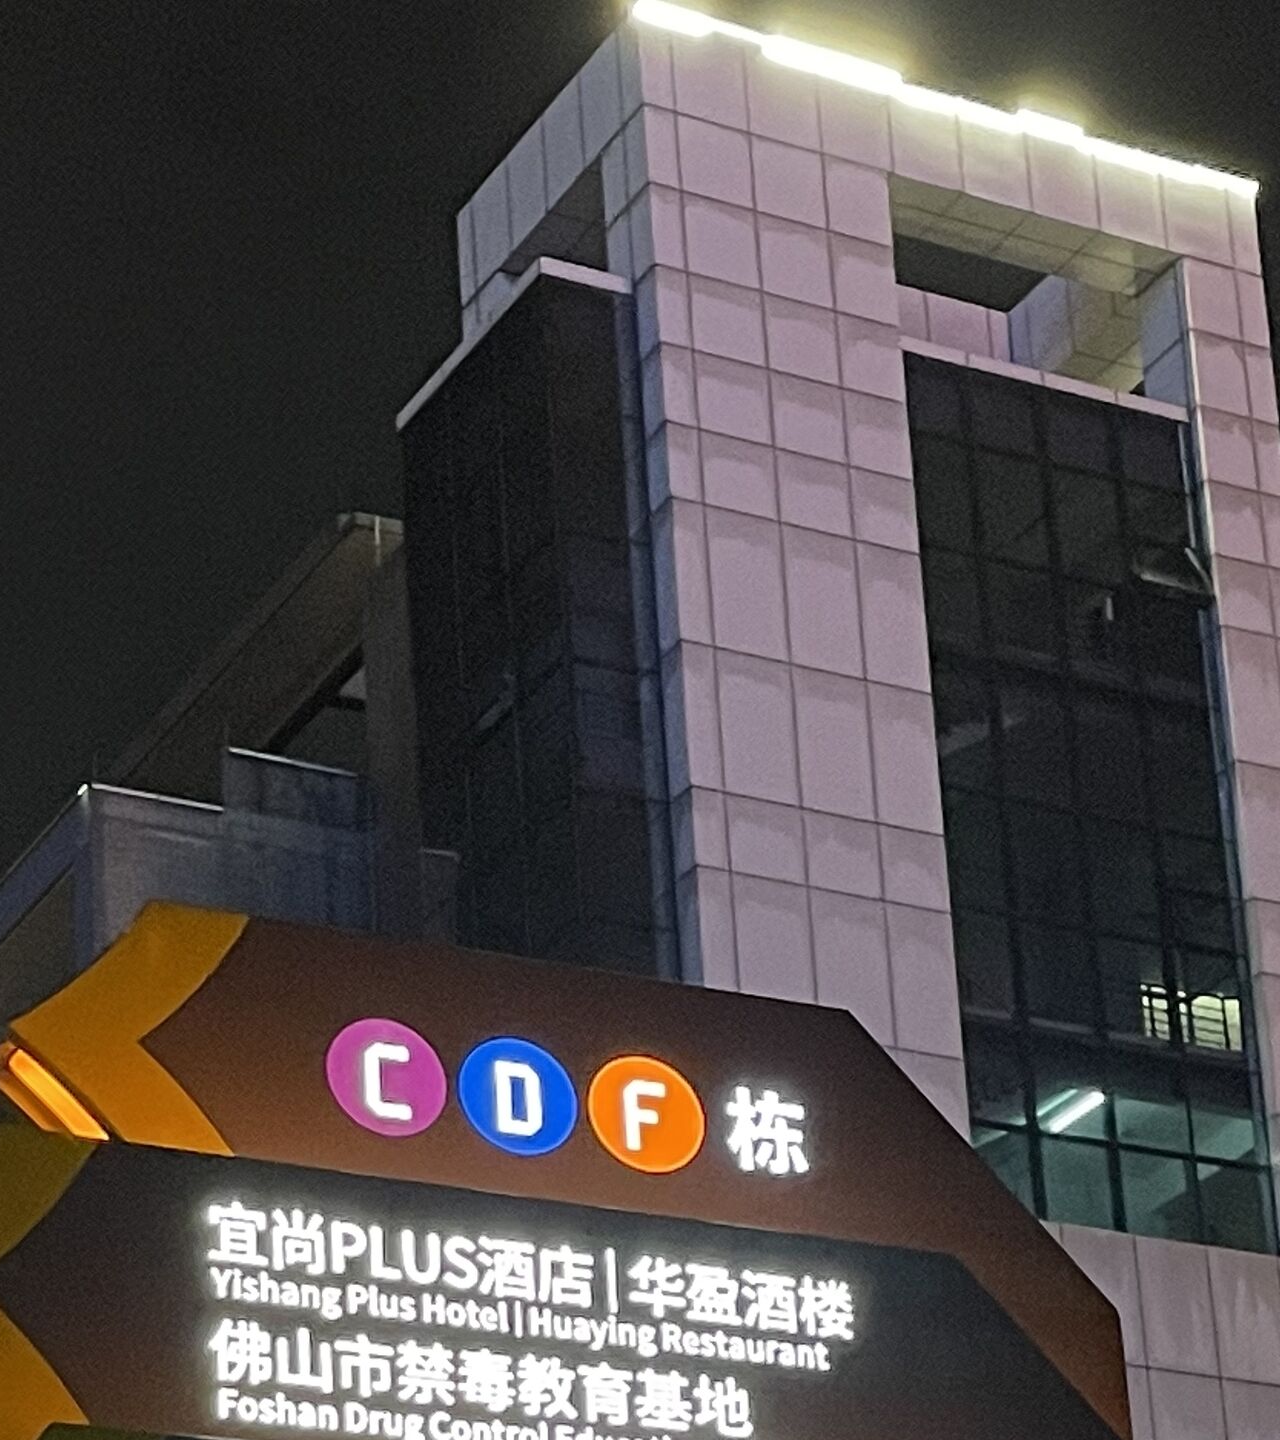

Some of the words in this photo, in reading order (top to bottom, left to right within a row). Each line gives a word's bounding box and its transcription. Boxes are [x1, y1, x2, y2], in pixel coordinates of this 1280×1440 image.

[361, 1041, 412, 1122] C
[493, 1058, 544, 1137] D
[621, 1079, 667, 1152] F
[725, 1085, 810, 1175] 栋
[209, 1266, 343, 1321] Yishang
[345, 1283, 417, 1322] Plus
[421, 1292, 511, 1334] Hotel
[529, 1305, 659, 1358] Huaying
[660, 1321, 832, 1372] Restaurant
[208, 1318, 754, 1438] 佛山市禁毒教育基地
[217, 1386, 339, 1431] Foshan
